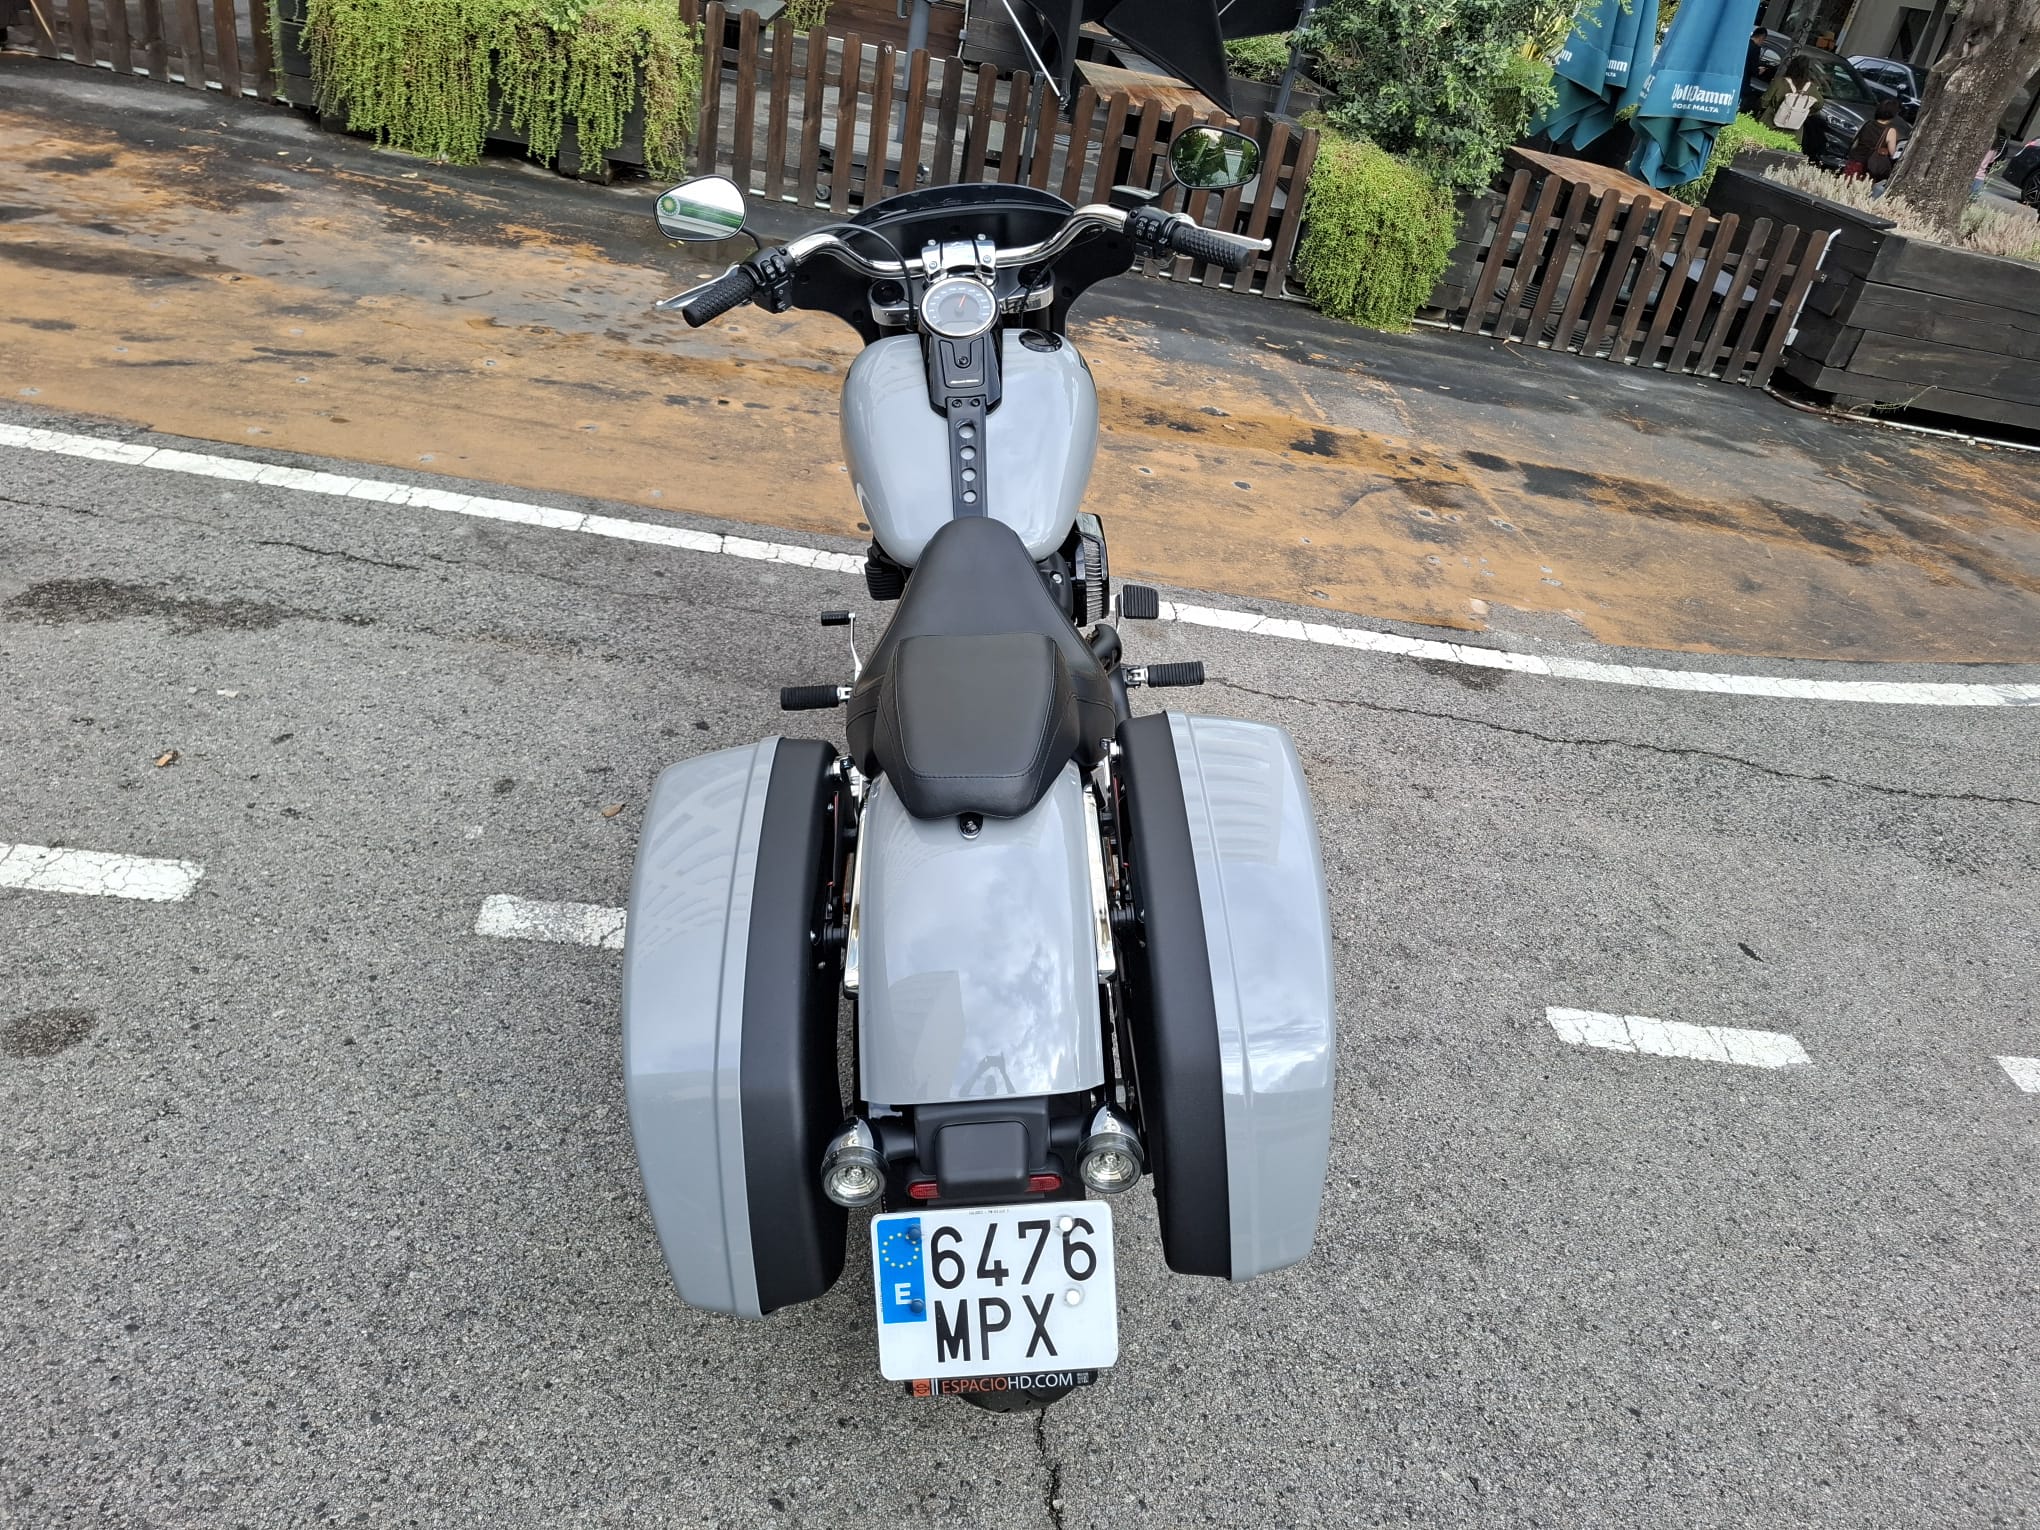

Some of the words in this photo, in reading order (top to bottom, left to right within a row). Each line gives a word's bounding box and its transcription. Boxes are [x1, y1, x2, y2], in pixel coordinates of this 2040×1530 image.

[1692, 104, 1719, 113] MALTA
[930, 1217, 1097, 1290] 6476
[894, 1282, 912, 1306] E
[934, 1293, 1058, 1363] MPX
[942, 1373, 1073, 1394] ESPACIOHD.COM
